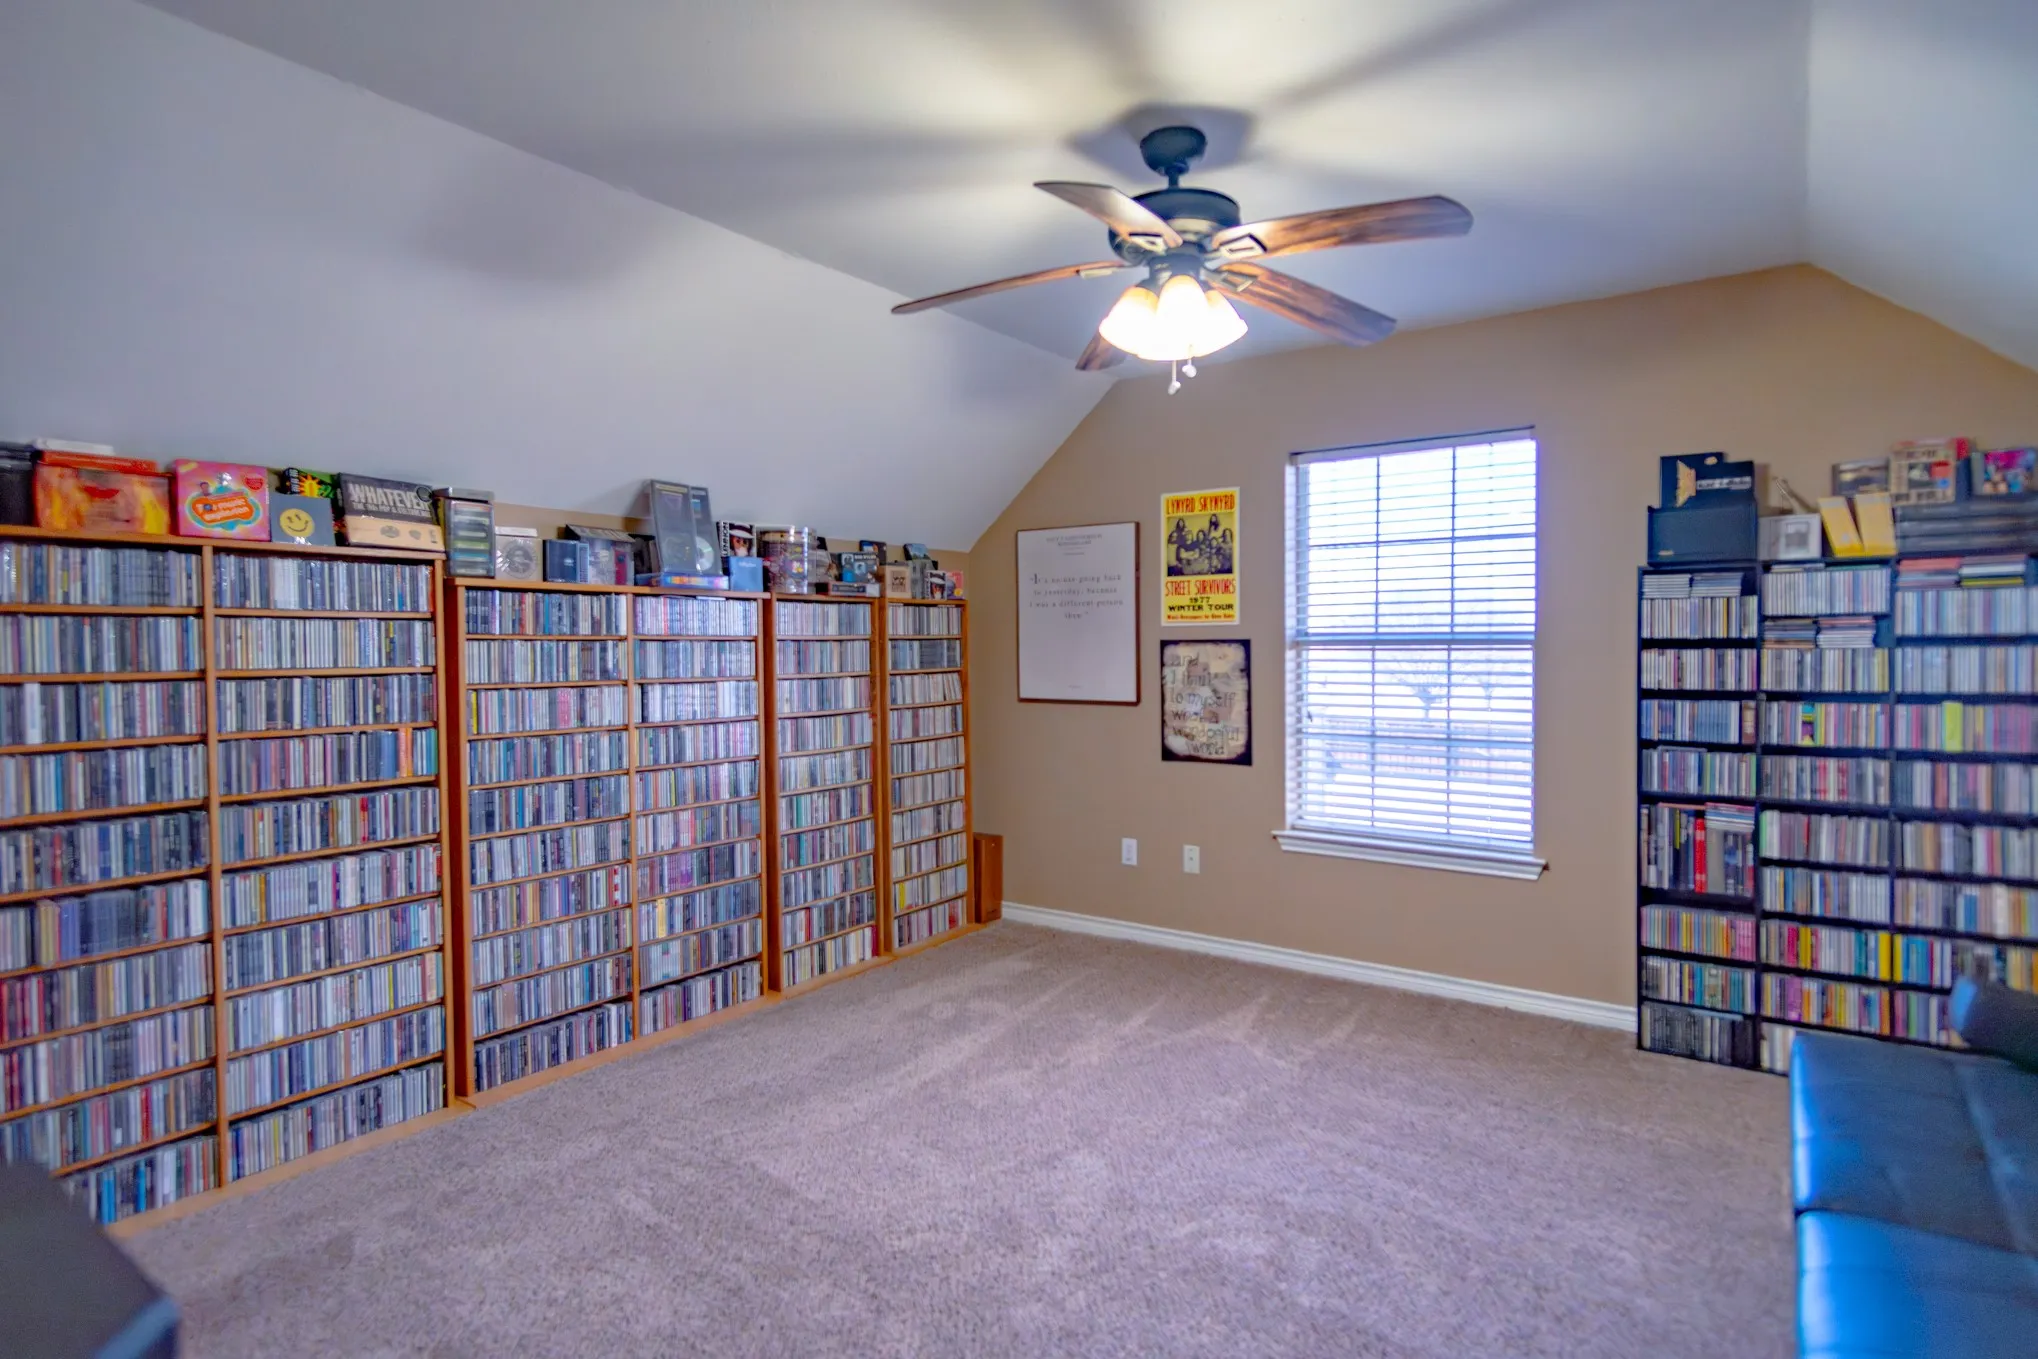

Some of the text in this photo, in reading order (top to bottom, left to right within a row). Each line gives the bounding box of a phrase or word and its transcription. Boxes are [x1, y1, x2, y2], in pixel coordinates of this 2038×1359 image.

[1166, 493, 1235, 515] LYNYRD SKYNYRD
[1165, 578, 1236, 597] STREET SURVIVORS
[1168, 603, 1234, 612] WINTER TOUR
